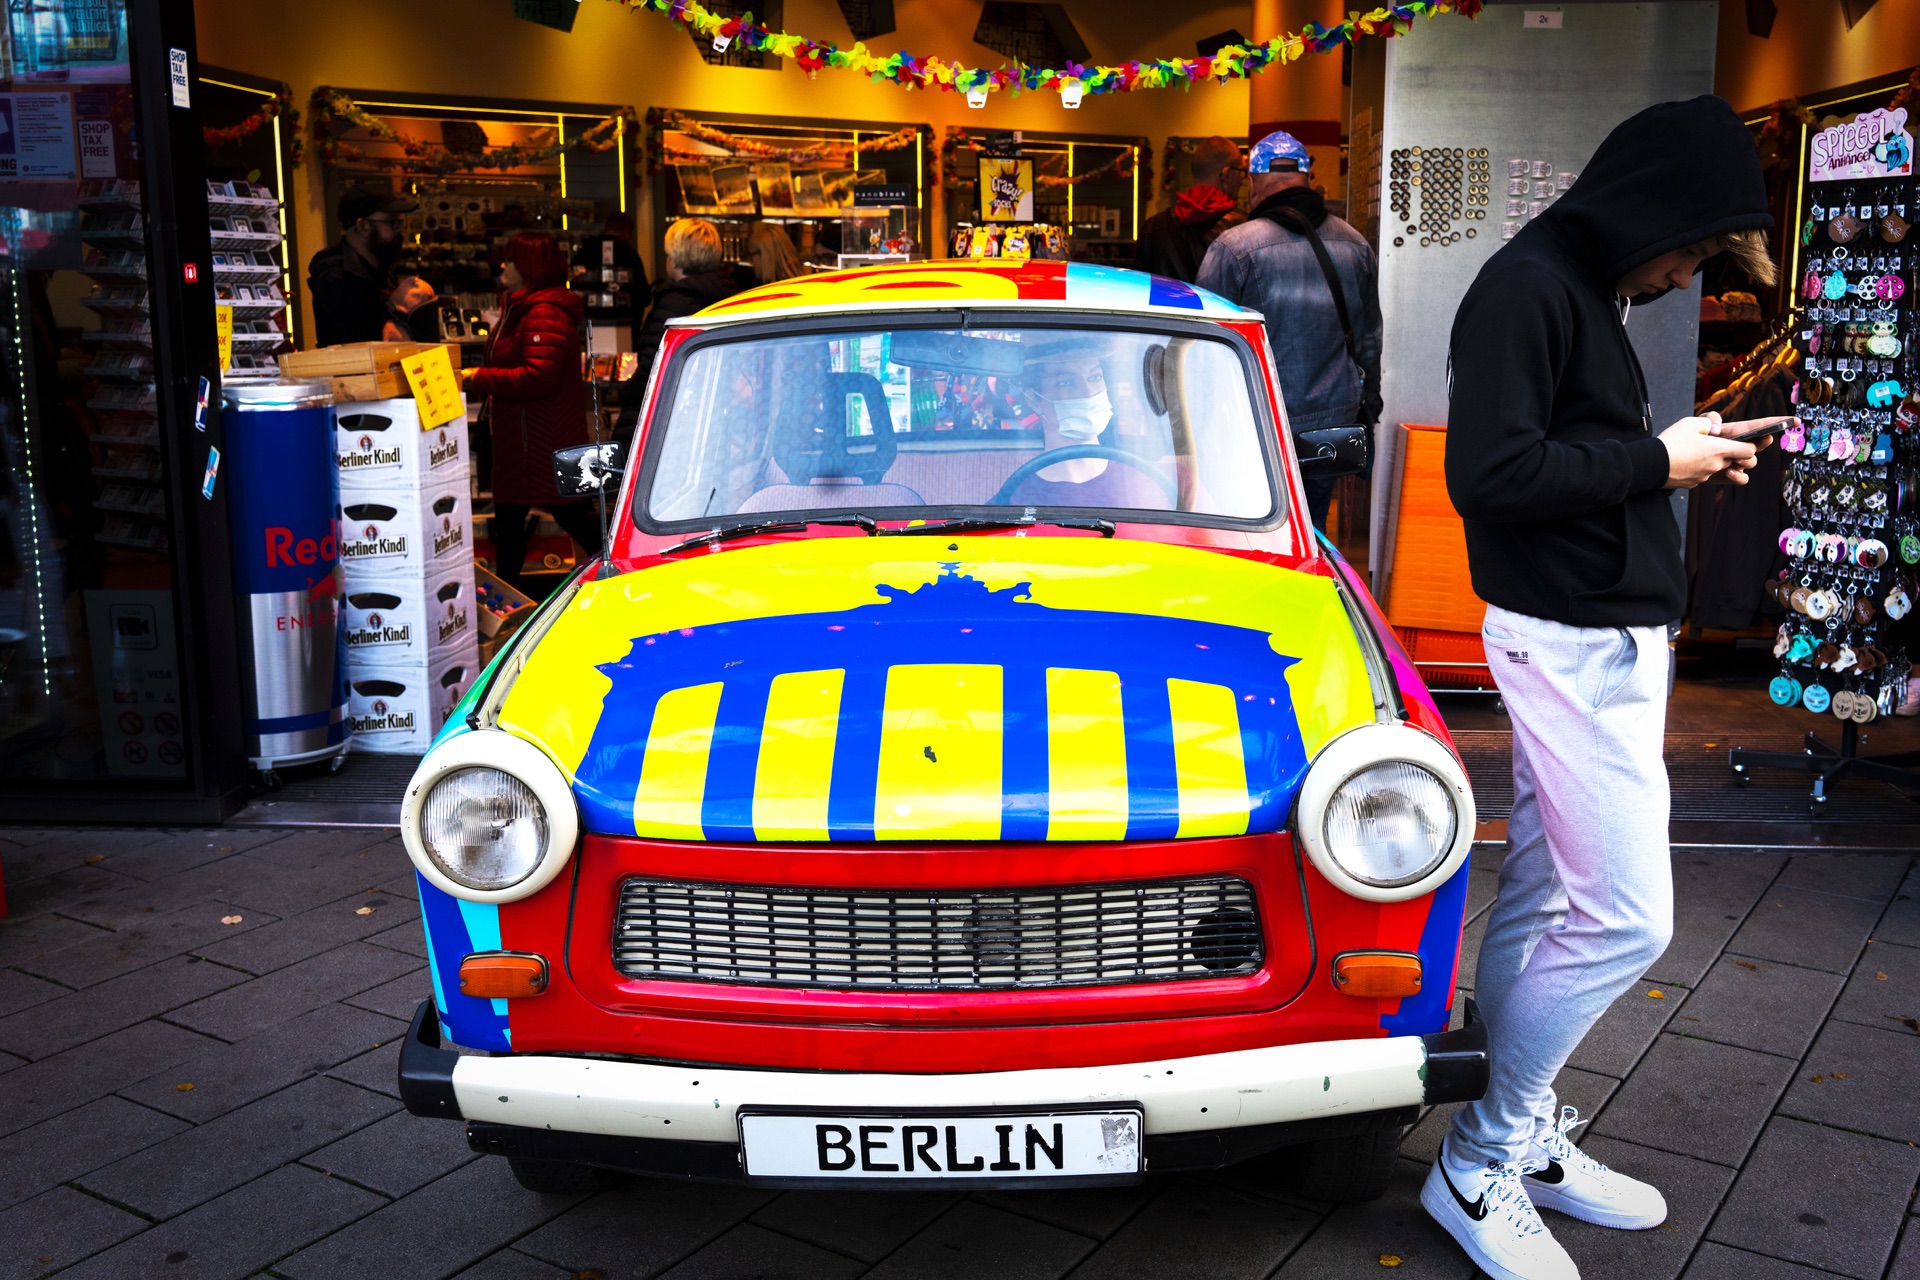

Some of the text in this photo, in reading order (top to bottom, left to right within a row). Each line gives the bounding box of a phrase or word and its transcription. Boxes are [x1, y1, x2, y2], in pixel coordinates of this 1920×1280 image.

[1539, 15, 1549, 23] 2€
[171, 51, 186, 63] SHOP
[172, 62, 183, 74] TAX
[173, 74, 186, 86] FREE
[81, 123, 110, 134] SHOP
[82, 135, 103, 145] TAX
[83, 147, 109, 157] FREE
[0, 159, 17, 170] NG
[374, 447, 400, 465] Kindl
[430, 443, 459, 466] Berliner Kindl
[265, 517, 337, 568] Red
[379, 536, 406, 553] Kindl
[434, 524, 462, 555] Berliner Kindl
[439, 609, 467, 641] Berliner Kindl
[383, 625, 410, 642] Kindl
[147, 670, 172, 679] VISA
[387, 712, 414, 729] Kindl
[815, 1123, 1064, 1172] BERLIN
